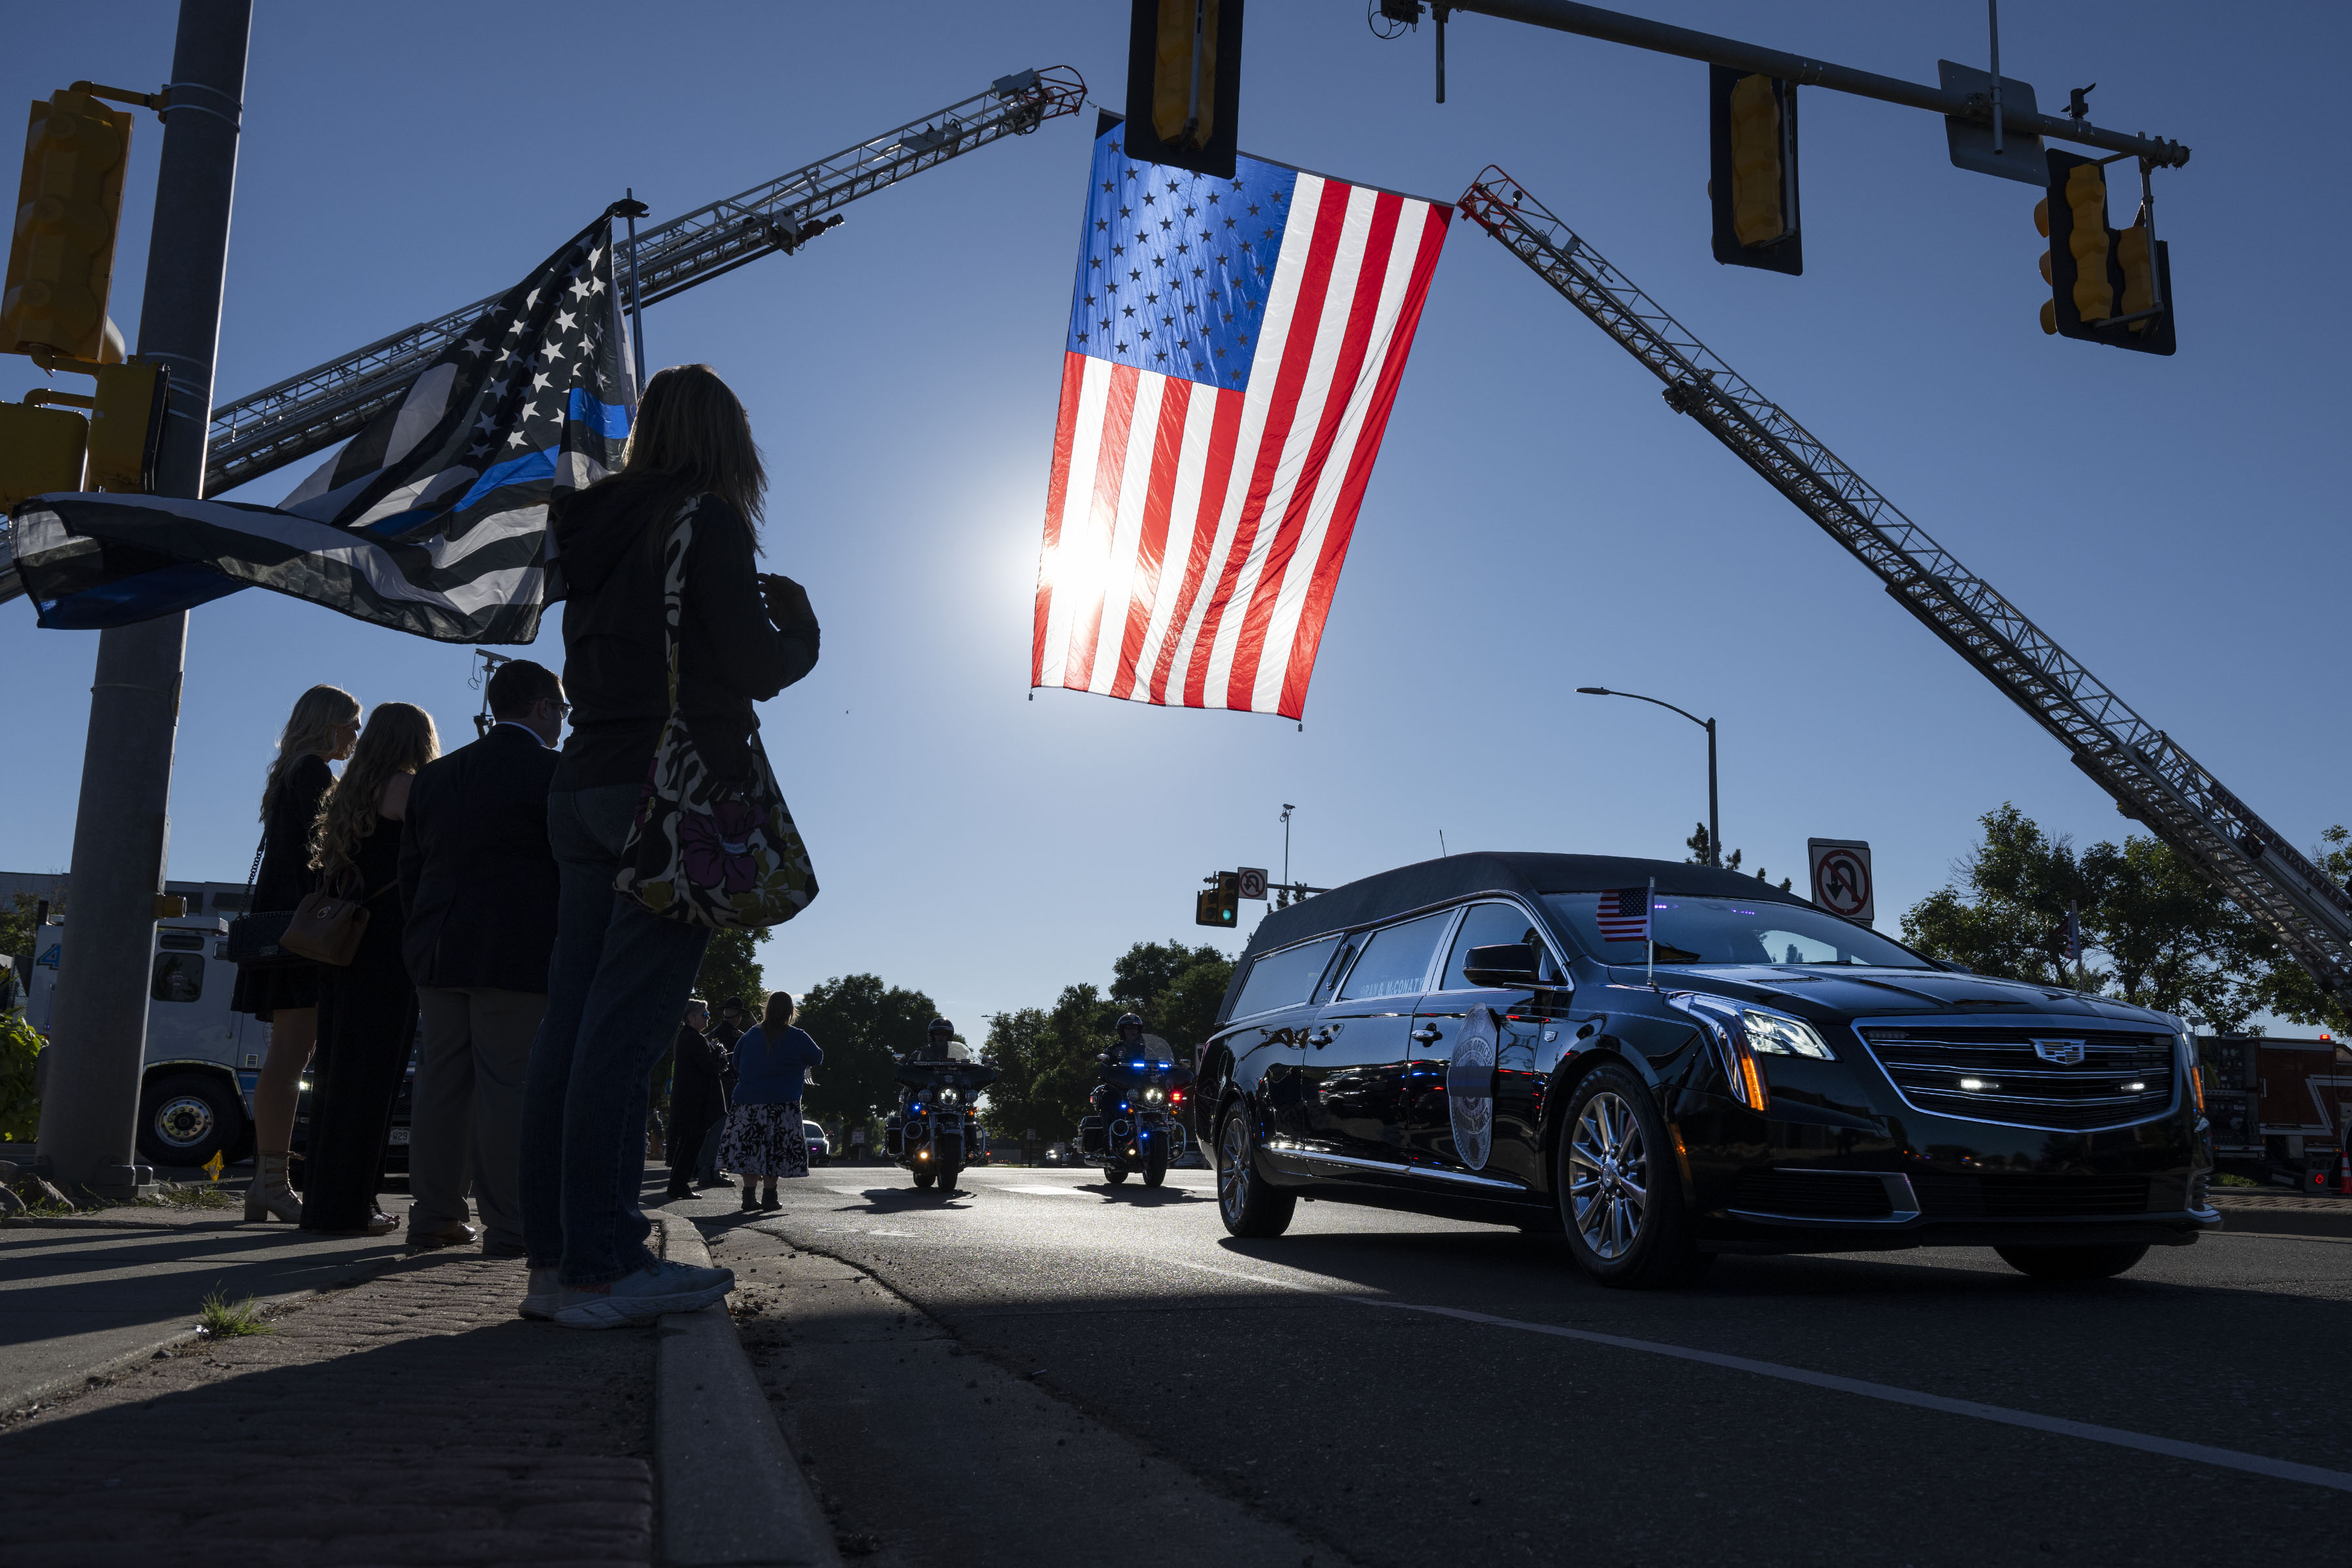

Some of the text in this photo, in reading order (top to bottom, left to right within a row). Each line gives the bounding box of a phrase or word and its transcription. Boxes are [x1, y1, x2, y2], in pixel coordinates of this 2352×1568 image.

[2213, 787, 2345, 906] CITY OF LAFAYETTE
[1379, 982, 1384, 996] &
[1473, 1039, 1494, 1066] OFFICER
